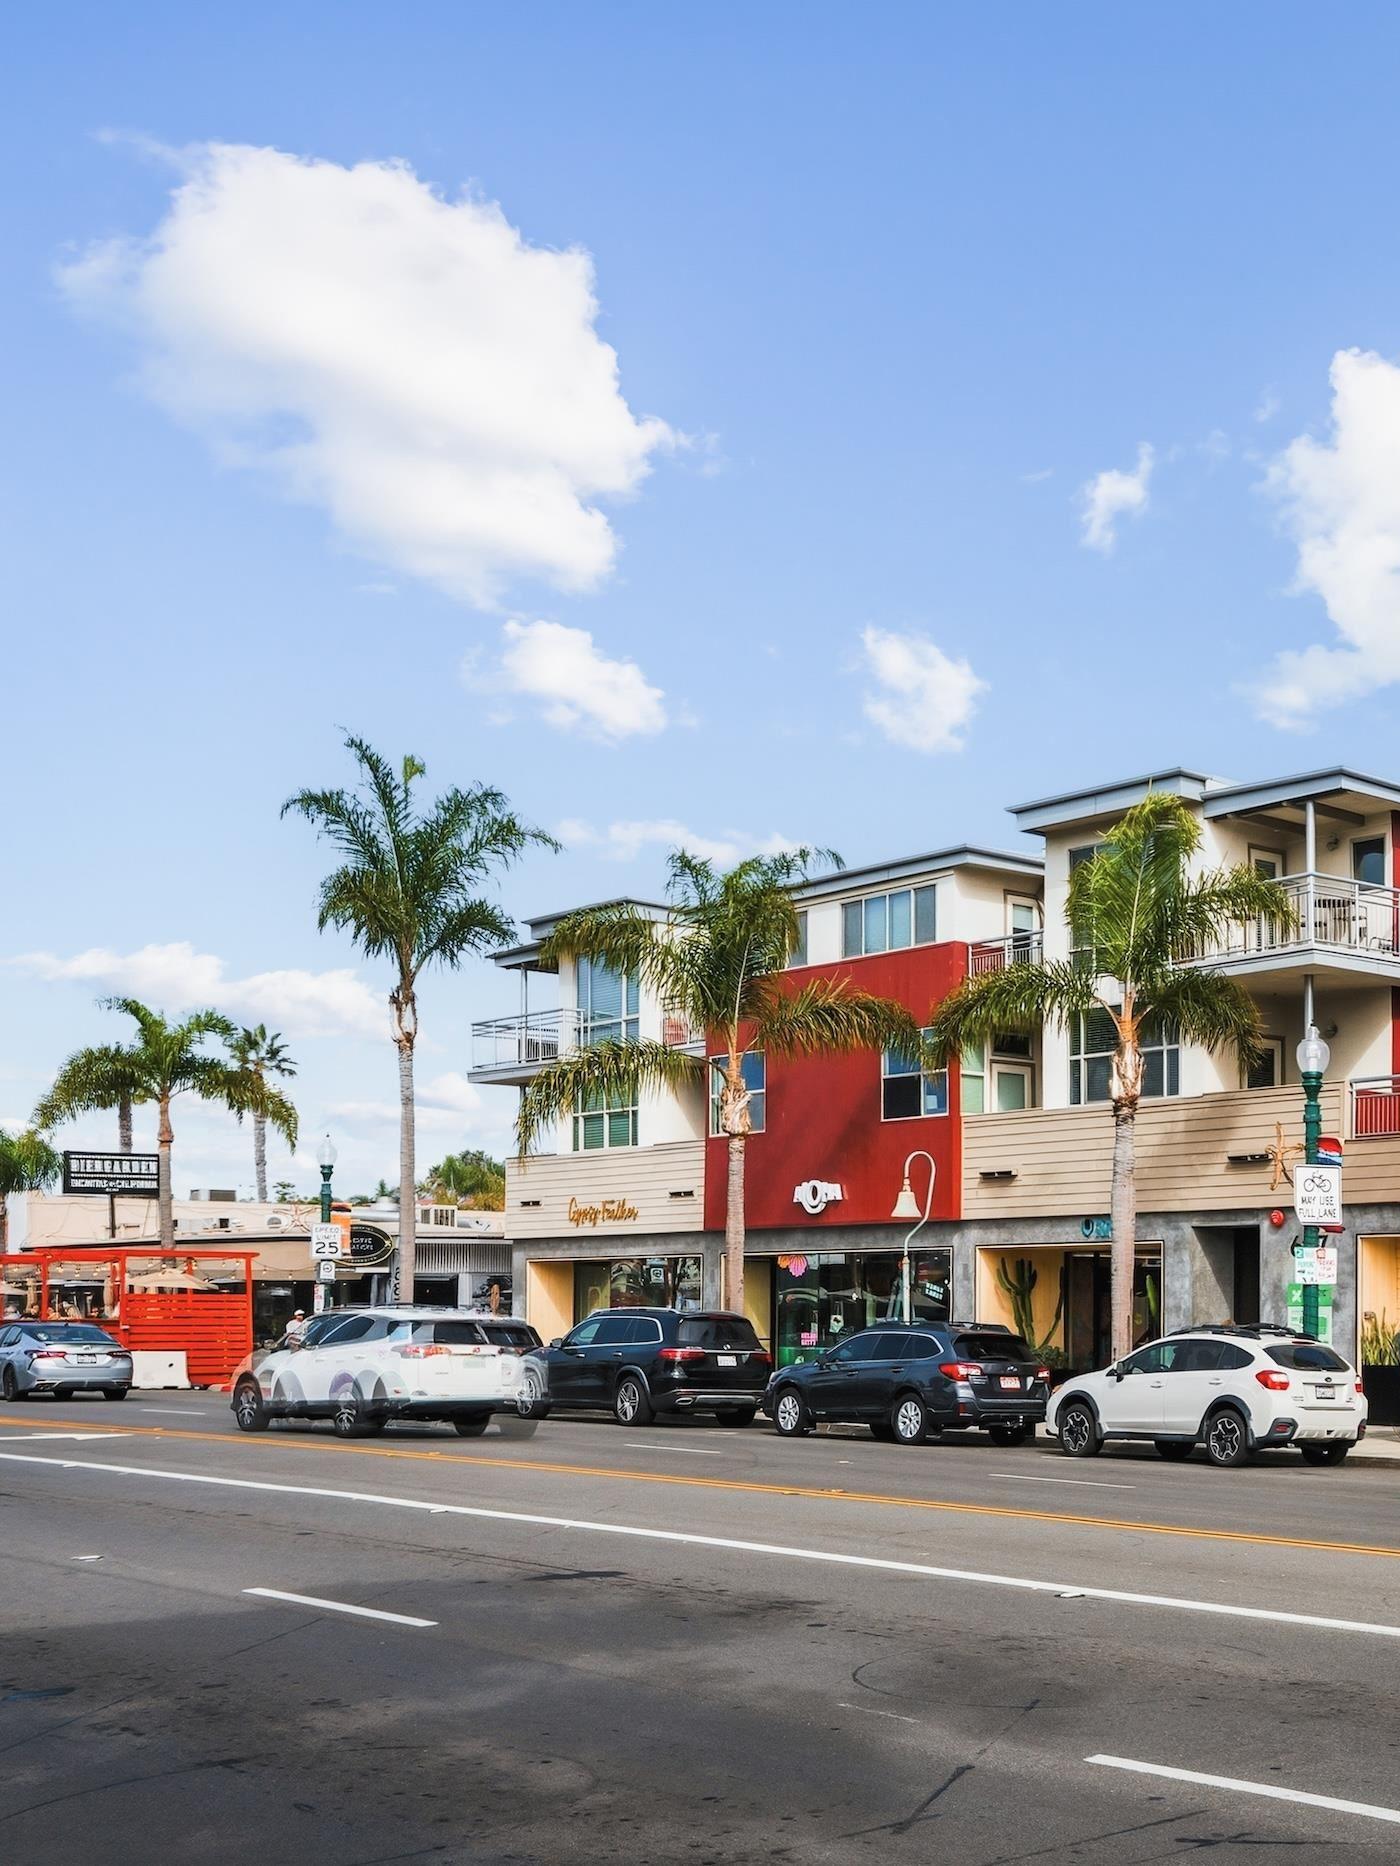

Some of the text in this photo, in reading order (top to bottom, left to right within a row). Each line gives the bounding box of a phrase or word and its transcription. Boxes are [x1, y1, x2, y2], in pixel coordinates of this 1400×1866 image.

[1301, 1196, 1334, 1206] MAY USE
[1298, 1207, 1337, 1218] FULL LANE
[315, 1241, 339, 1255] 25
